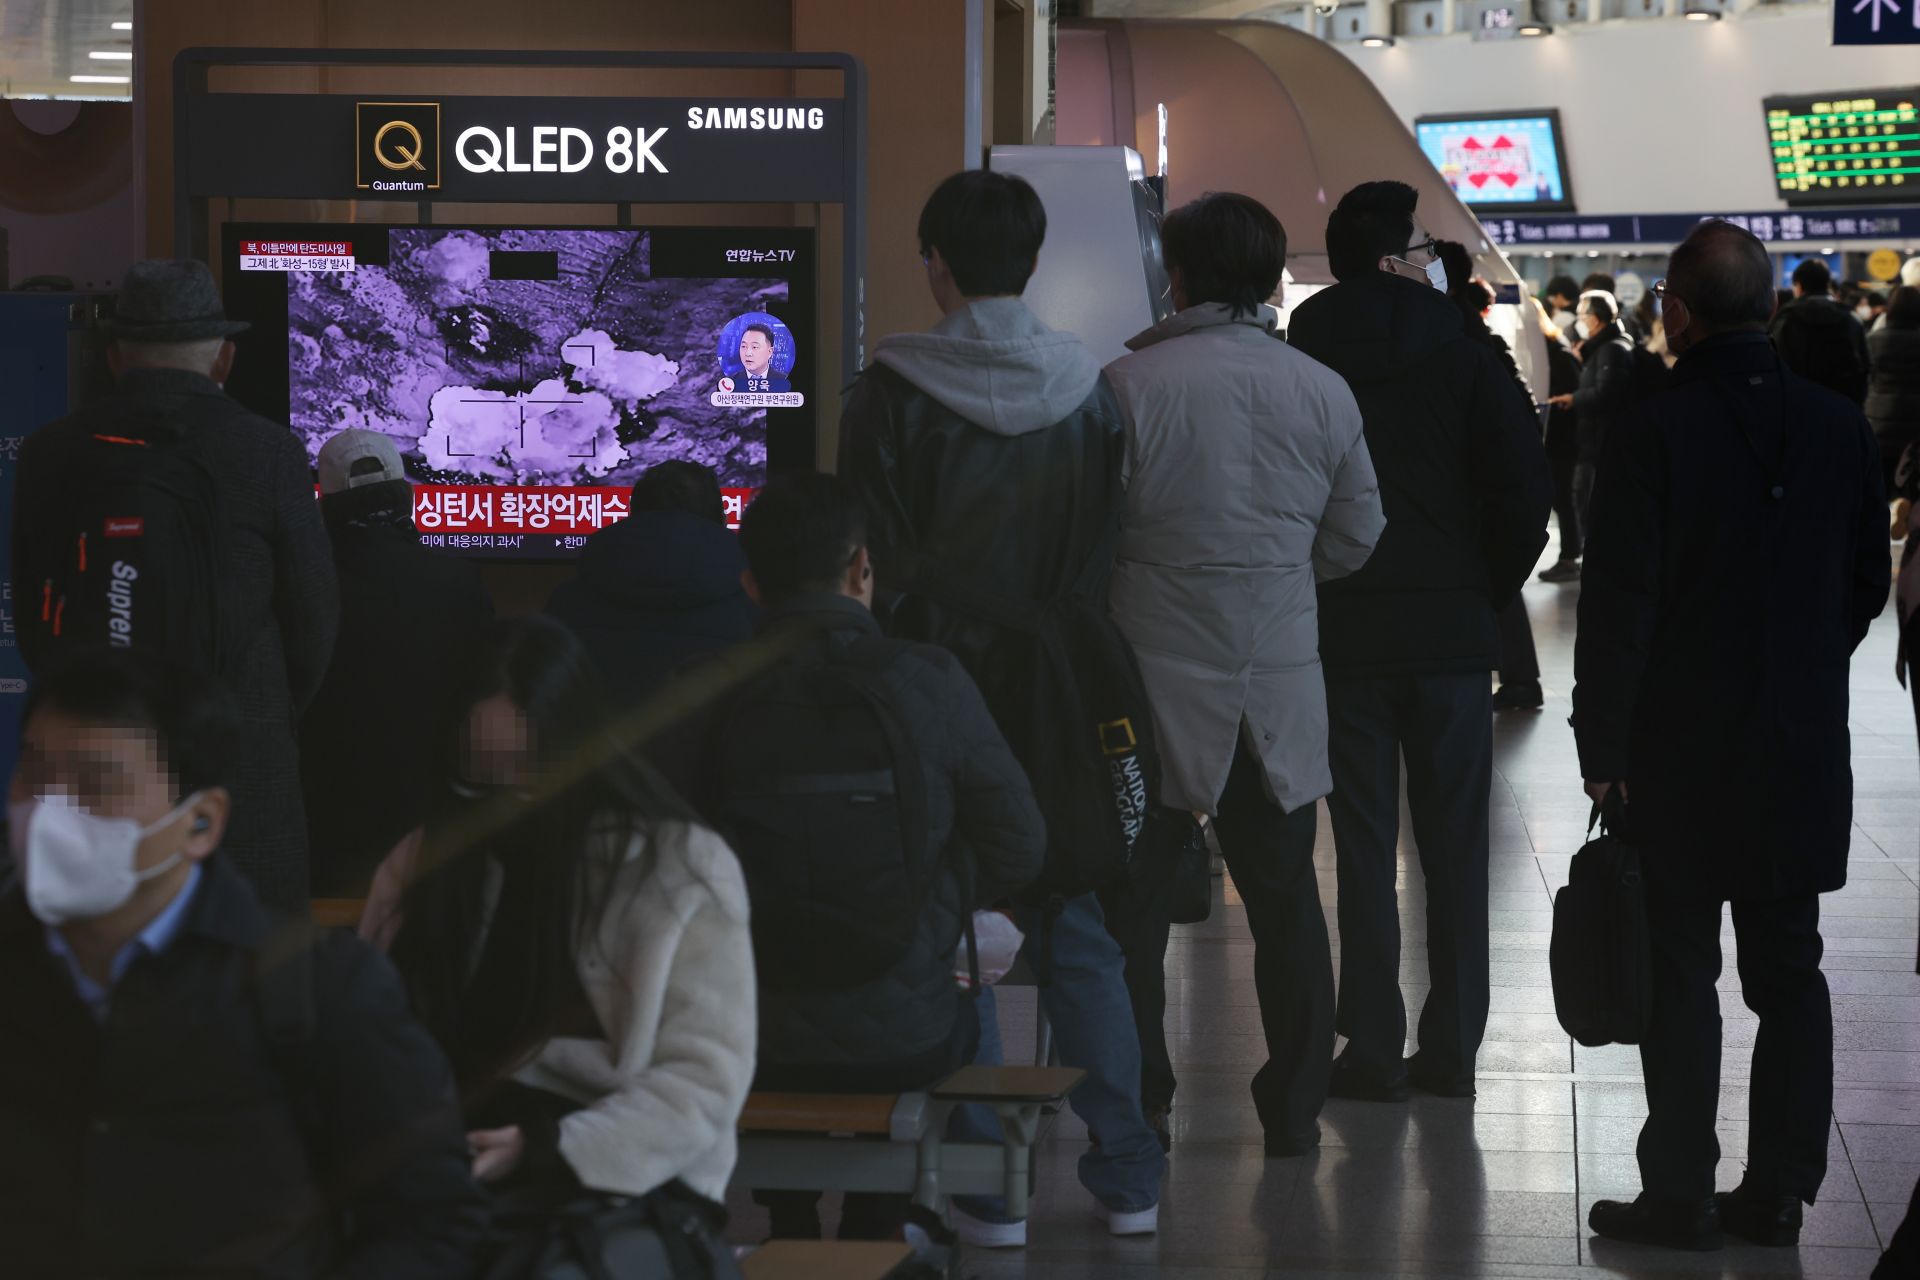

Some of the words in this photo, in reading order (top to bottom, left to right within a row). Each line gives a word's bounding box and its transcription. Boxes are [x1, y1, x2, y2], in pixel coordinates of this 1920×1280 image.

[687, 106, 825, 130] SAMSUNG
[455, 126, 594, 173] QLED
[605, 126, 669, 173] 8K
[372, 179, 424, 191] Quantum
[261, 243, 298, 254] 이틀만에
[299, 243, 346, 255] 탄도미사일
[725, 248, 796, 263] 연합뉴스TV
[247, 257, 267, 269] 그제
[330, 258, 350, 270] 발사
[717, 394, 764, 405] 아산정책연구원
[765, 394, 799, 405] 부연구위원
[411, 491, 493, 528] 싱턴서
[499, 492, 632, 529] 확장억제수
[419, 534, 445, 548] 미에
[448, 535, 494, 548] 대응의지
